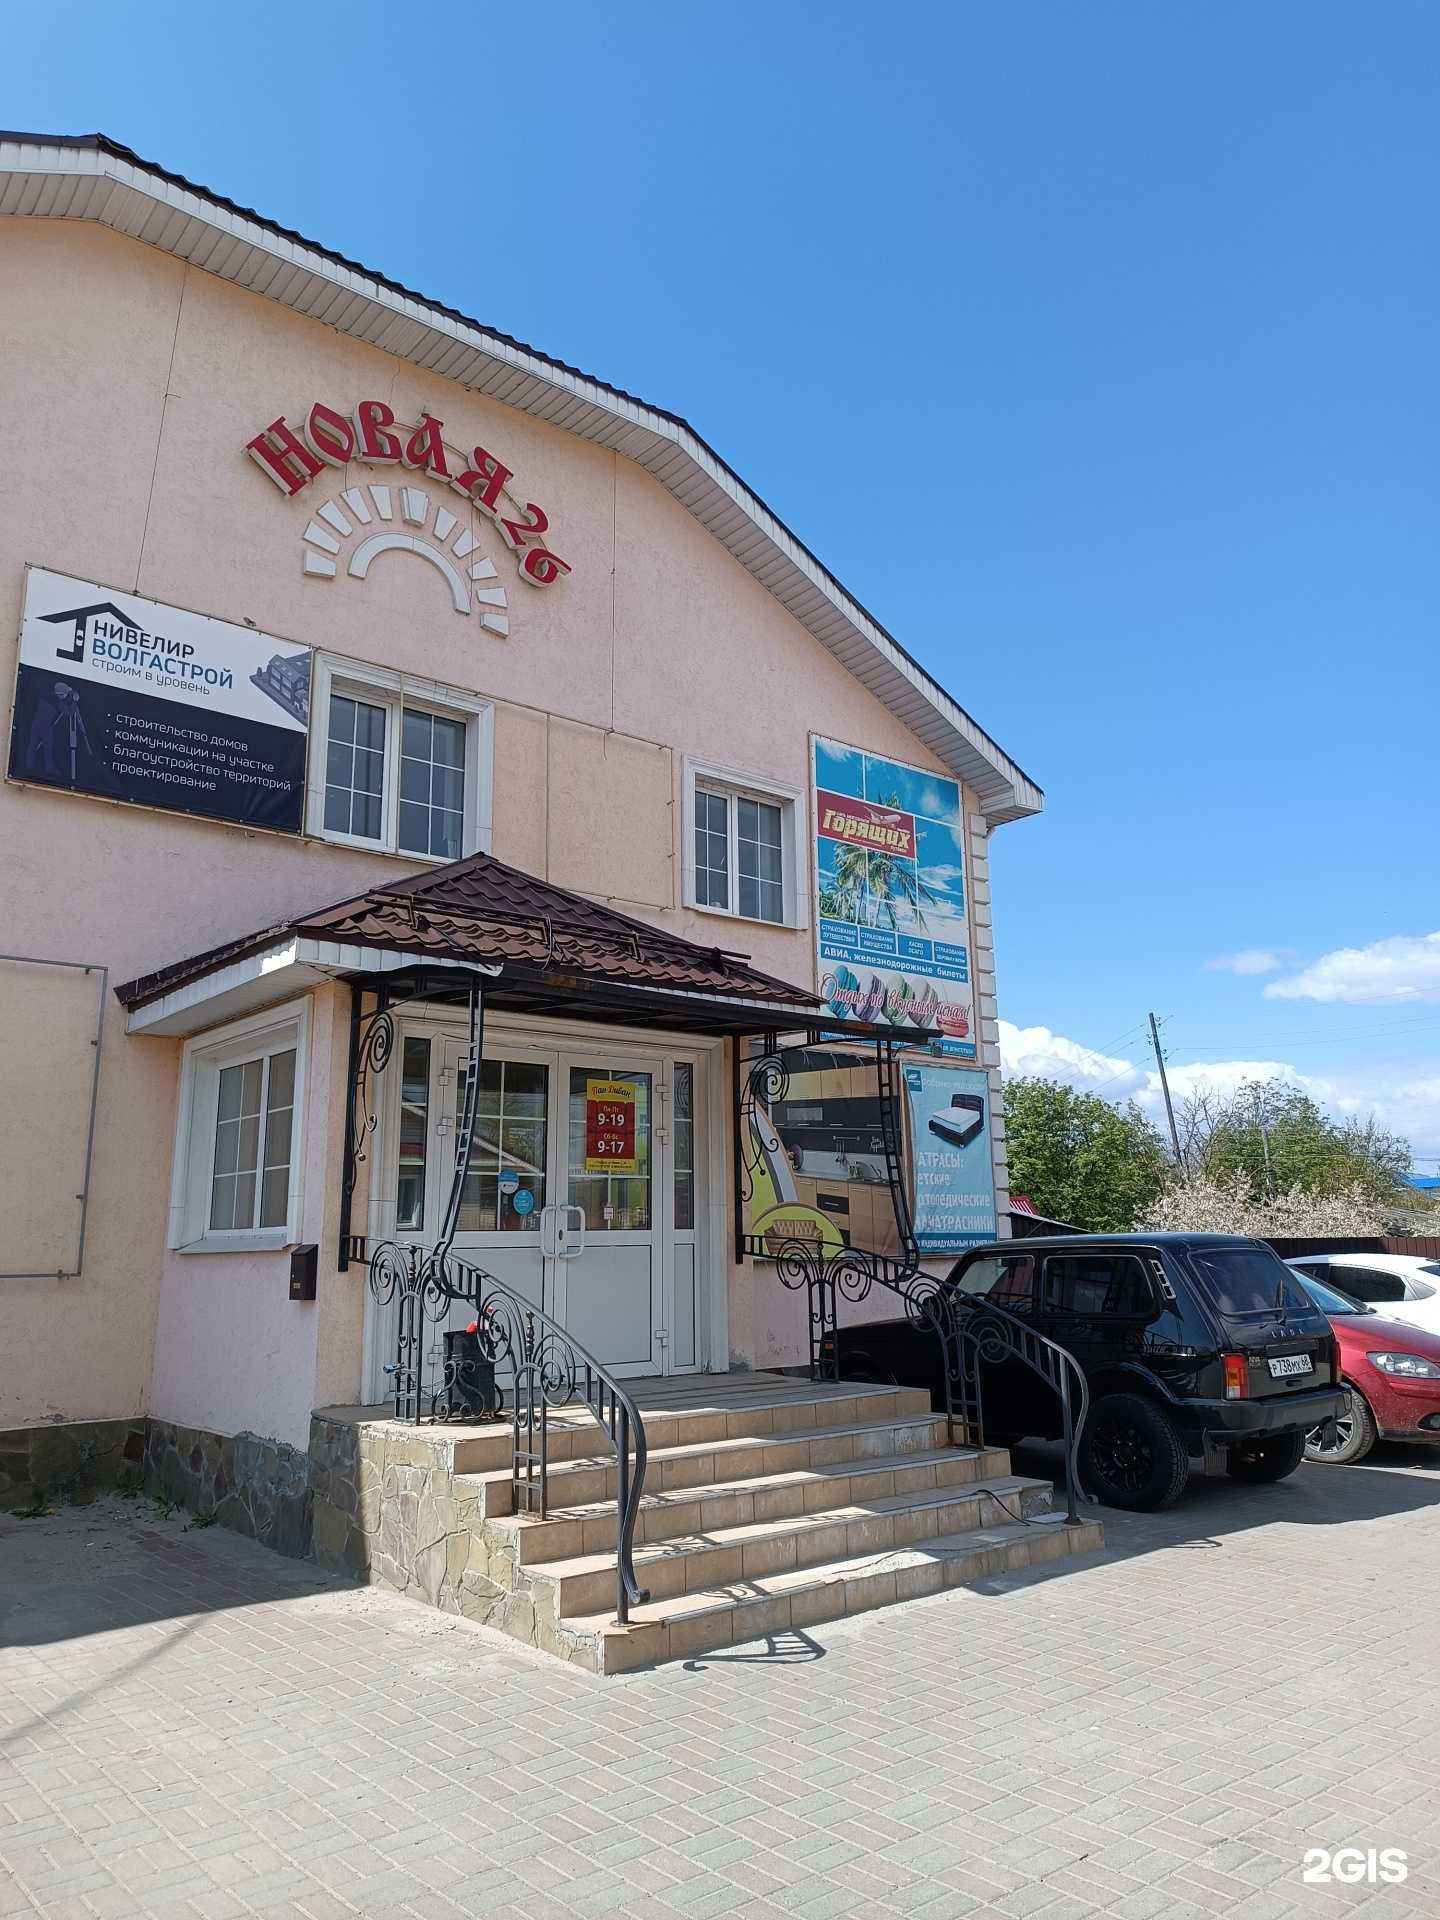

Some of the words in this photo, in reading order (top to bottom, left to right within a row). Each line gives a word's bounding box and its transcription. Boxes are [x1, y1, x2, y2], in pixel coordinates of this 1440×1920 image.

[500, 502, 573, 588] 26
[93, 619, 196, 659] НИВЕЛИР
[91, 638, 234, 690] ВОЛГАСТРОЙ
[91, 658, 142, 679] строим
[145, 670, 153, 681] в
[156, 673, 211, 696] уровень
[114, 729, 209, 759] коммуникации
[211, 751, 226, 762] на
[229, 755, 275, 773] участке
[116, 713, 208, 743] строительство
[210, 735, 249, 752] домов
[112, 760, 217, 791] проектирование
[113, 743, 221, 777] благоустройство
[223, 767, 292, 792] территорий
[823, 946, 852, 961] АВИА,
[853, 953, 933, 974] железнодорожные
[937, 967, 966, 979] билеты
[592, 1086, 606, 1095] Пан
[608, 1084, 631, 1098] Диван
[597, 1113, 625, 1126] 9-19
[597, 1140, 625, 1153] 9-17
